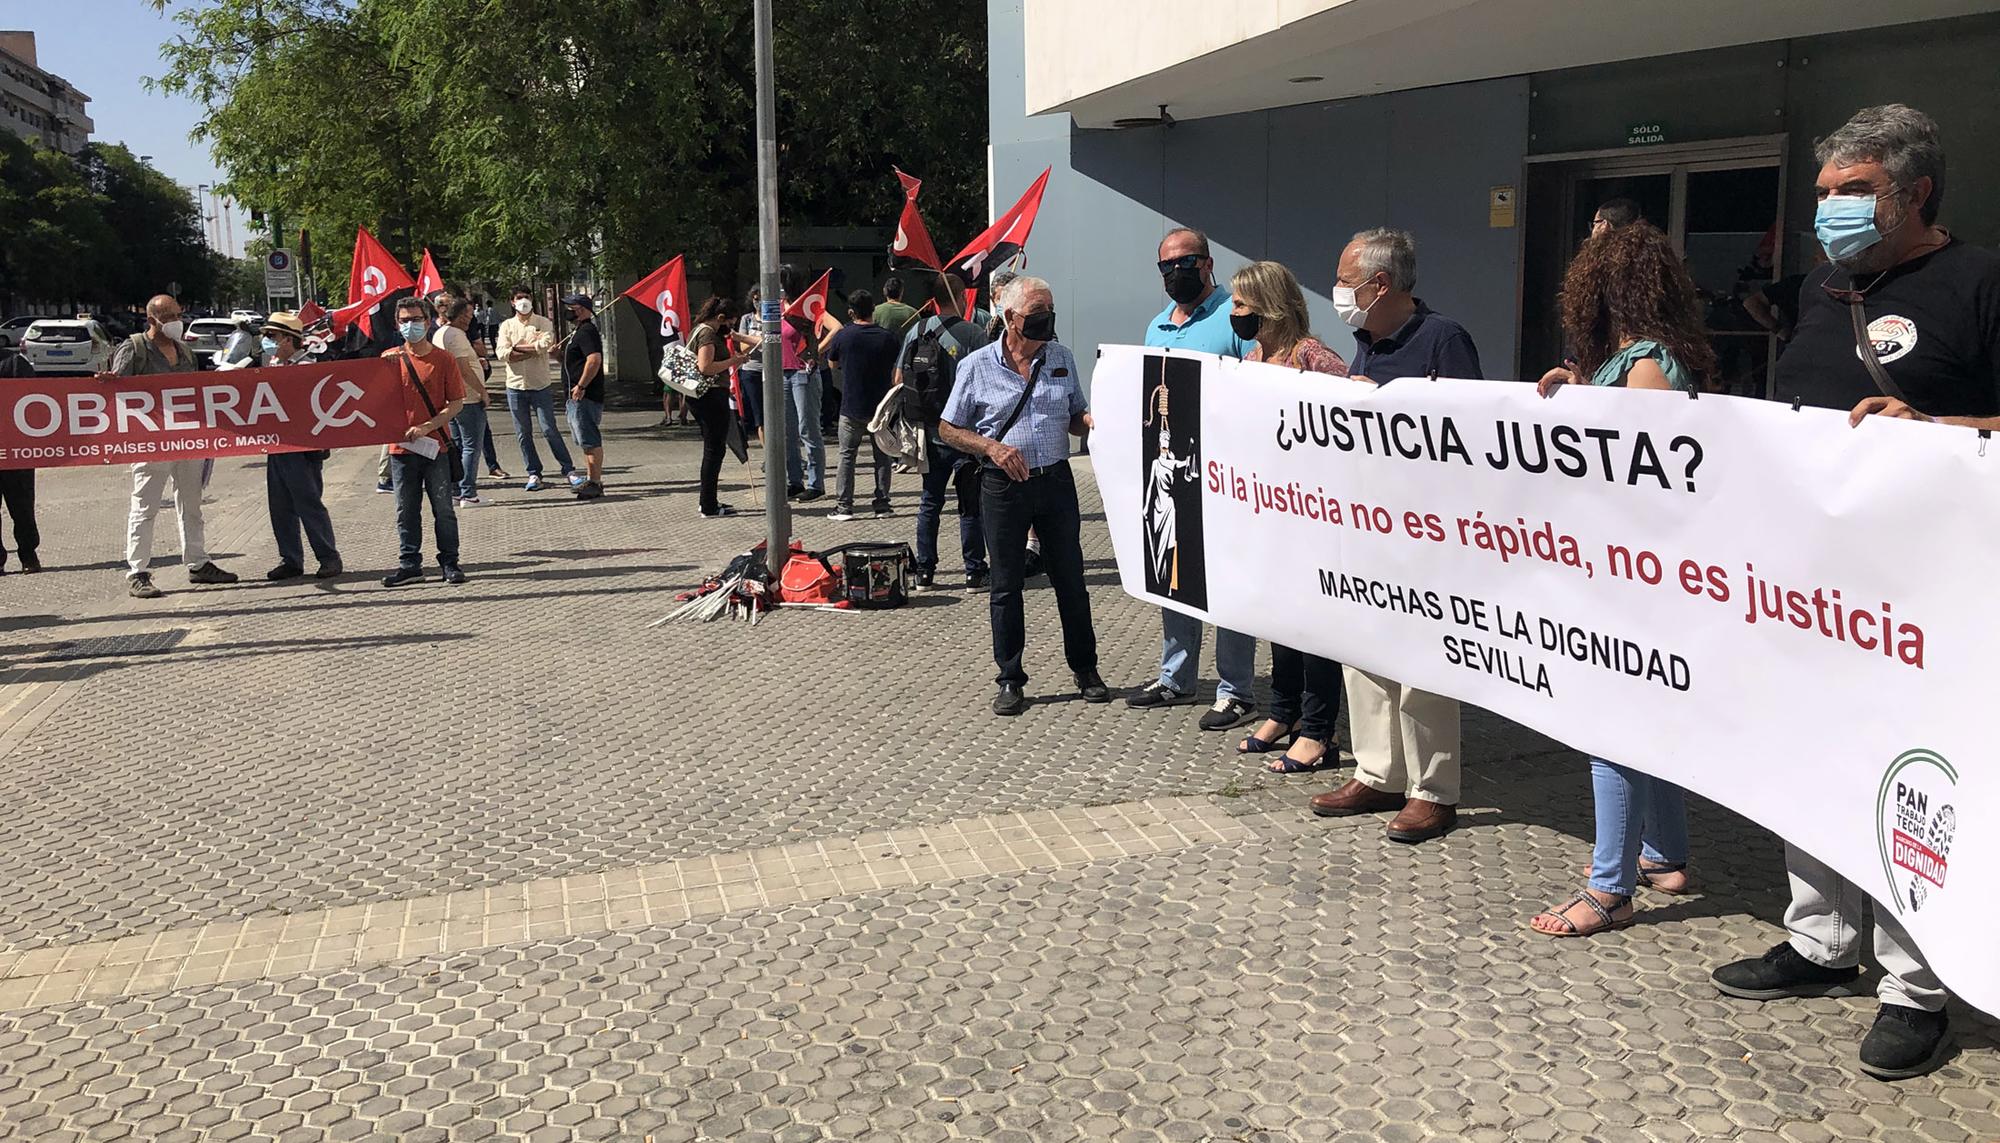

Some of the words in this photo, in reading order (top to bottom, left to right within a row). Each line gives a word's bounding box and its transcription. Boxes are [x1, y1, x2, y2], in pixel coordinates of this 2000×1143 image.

[1628, 134, 1664, 144] SALIDA
[13, 381, 290, 437] OBRERA
[12, 446, 65, 459] TODOS
[70, 444, 100, 456] LOS
[104, 440, 157, 455] PAÍSES
[161, 438, 209, 452] UNÍOS!
[213, 437, 232, 450] (C.
[235, 433, 280, 446] MARX)
[1276, 400, 1474, 466] ¿JUSTICIA
[1485, 419, 1704, 493] JUSTA?
[1208, 460, 1226, 495] Si
[1230, 466, 1248, 502] la
[1252, 472, 1343, 526] justicia
[1350, 502, 1393, 534] no
[1403, 511, 1446, 543] es
[1456, 511, 1594, 579] rápida,
[1606, 543, 1663, 586] no
[1678, 557, 1731, 603] es
[1745, 561, 1925, 671] justicia
[1318, 568, 1444, 620] MARCHAS
[1449, 595, 1489, 632] DE
[1495, 604, 1533, 645] LA
[1539, 616, 1691, 692] DIGNIDAD
[1443, 635, 1554, 699] SEVILLA
[1896, 782, 1928, 816] PAN
[1896, 803, 1926, 826] TRABAJO
[1896, 814, 1925, 840] TECHO
[1895, 841, 1946, 887] DIGNIDAD
